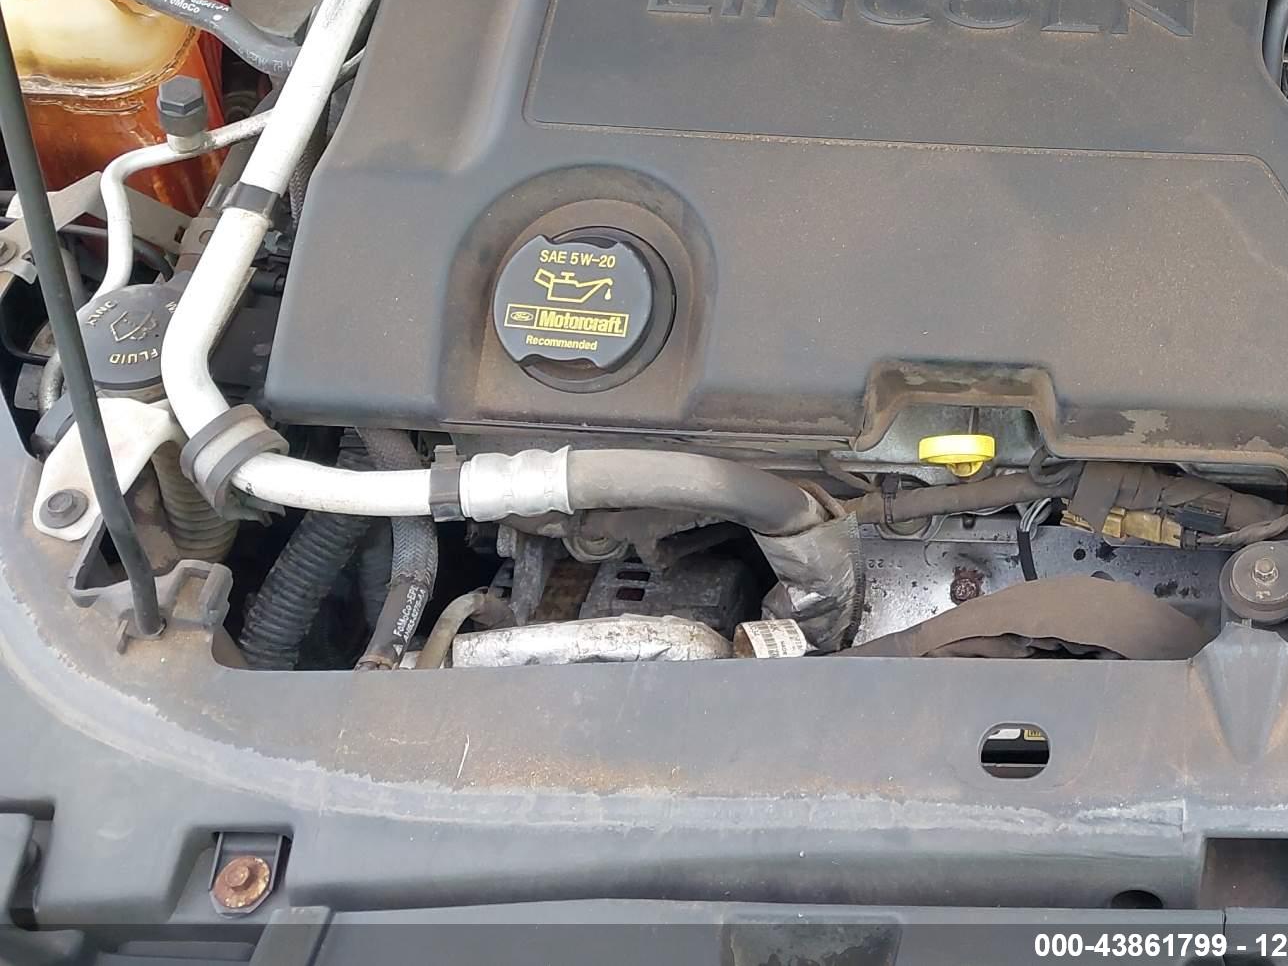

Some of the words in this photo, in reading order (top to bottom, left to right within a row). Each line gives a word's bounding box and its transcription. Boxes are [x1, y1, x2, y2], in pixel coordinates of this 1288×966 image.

[539, 249, 567, 265] SAE
[570, 251, 616, 269] 5W-20
[526, 334, 598, 351] Recommended
[109, 348, 161, 365] FLUID
